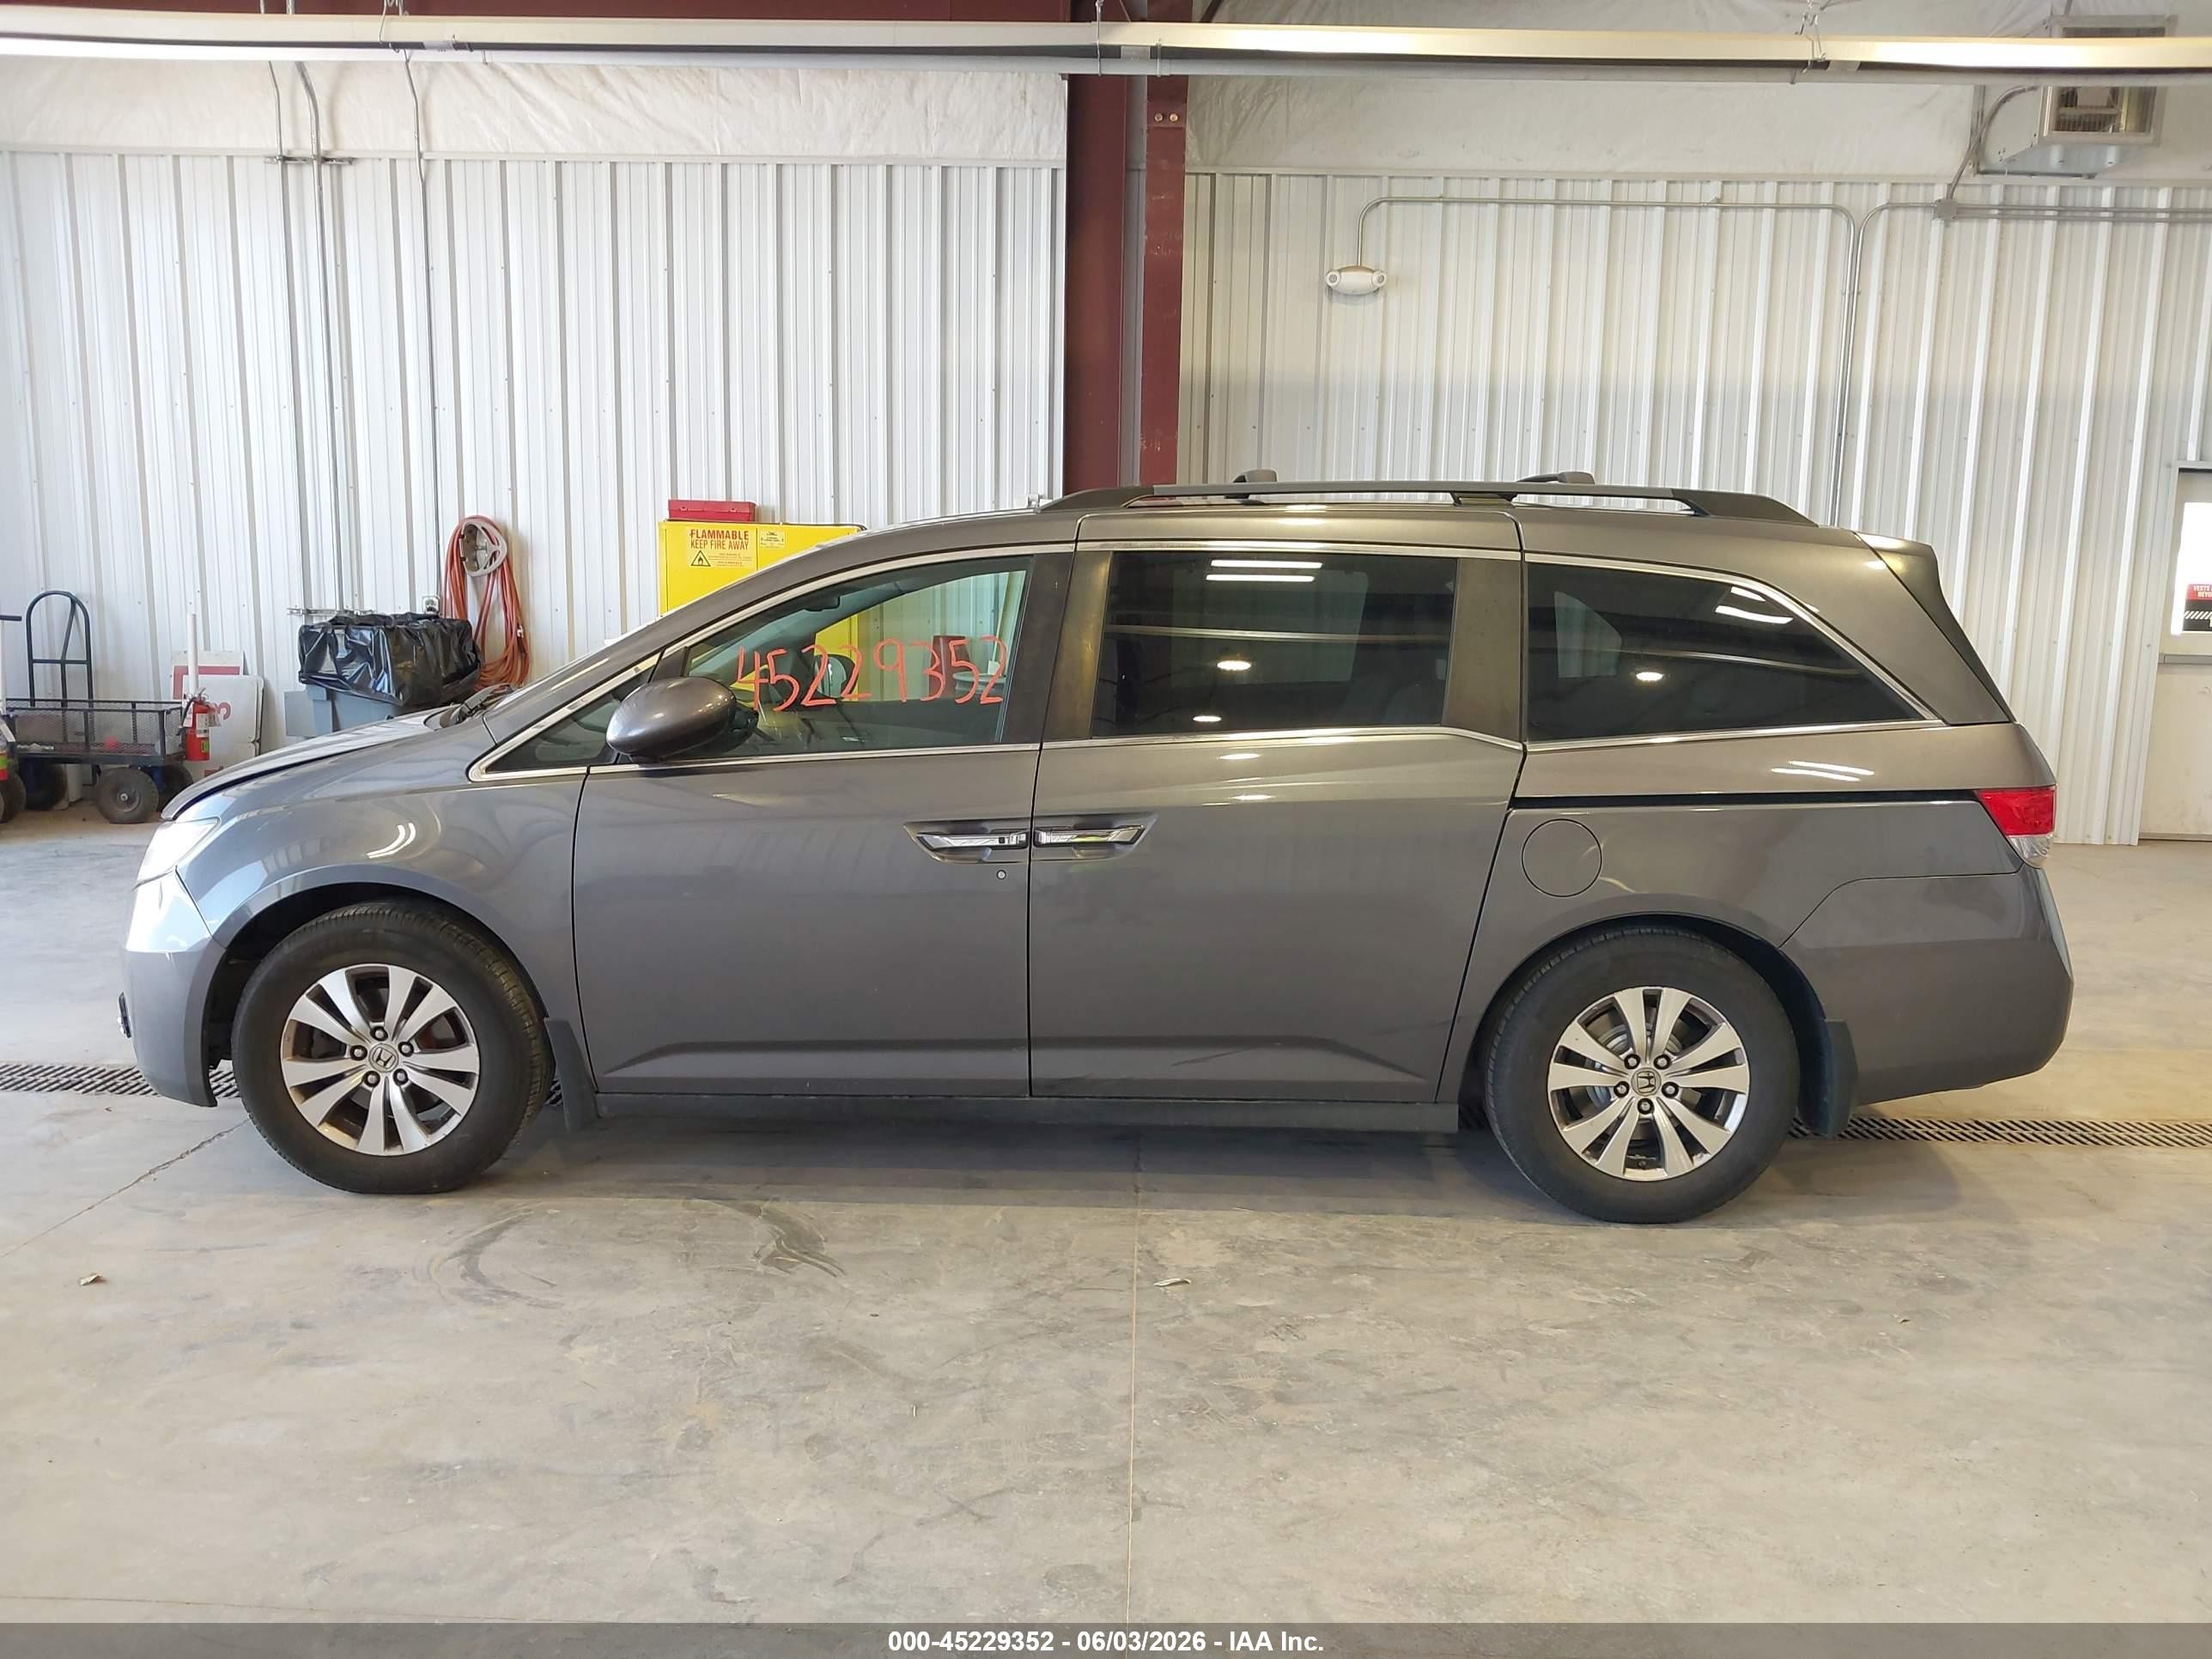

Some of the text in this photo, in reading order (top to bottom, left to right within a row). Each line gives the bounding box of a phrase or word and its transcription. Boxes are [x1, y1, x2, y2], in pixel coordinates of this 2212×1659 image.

[690, 529, 750, 540] FLAMMABLE
[690, 539, 749, 550] KEEP FIRE AWAY
[736, 635, 1007, 712] 45229352
